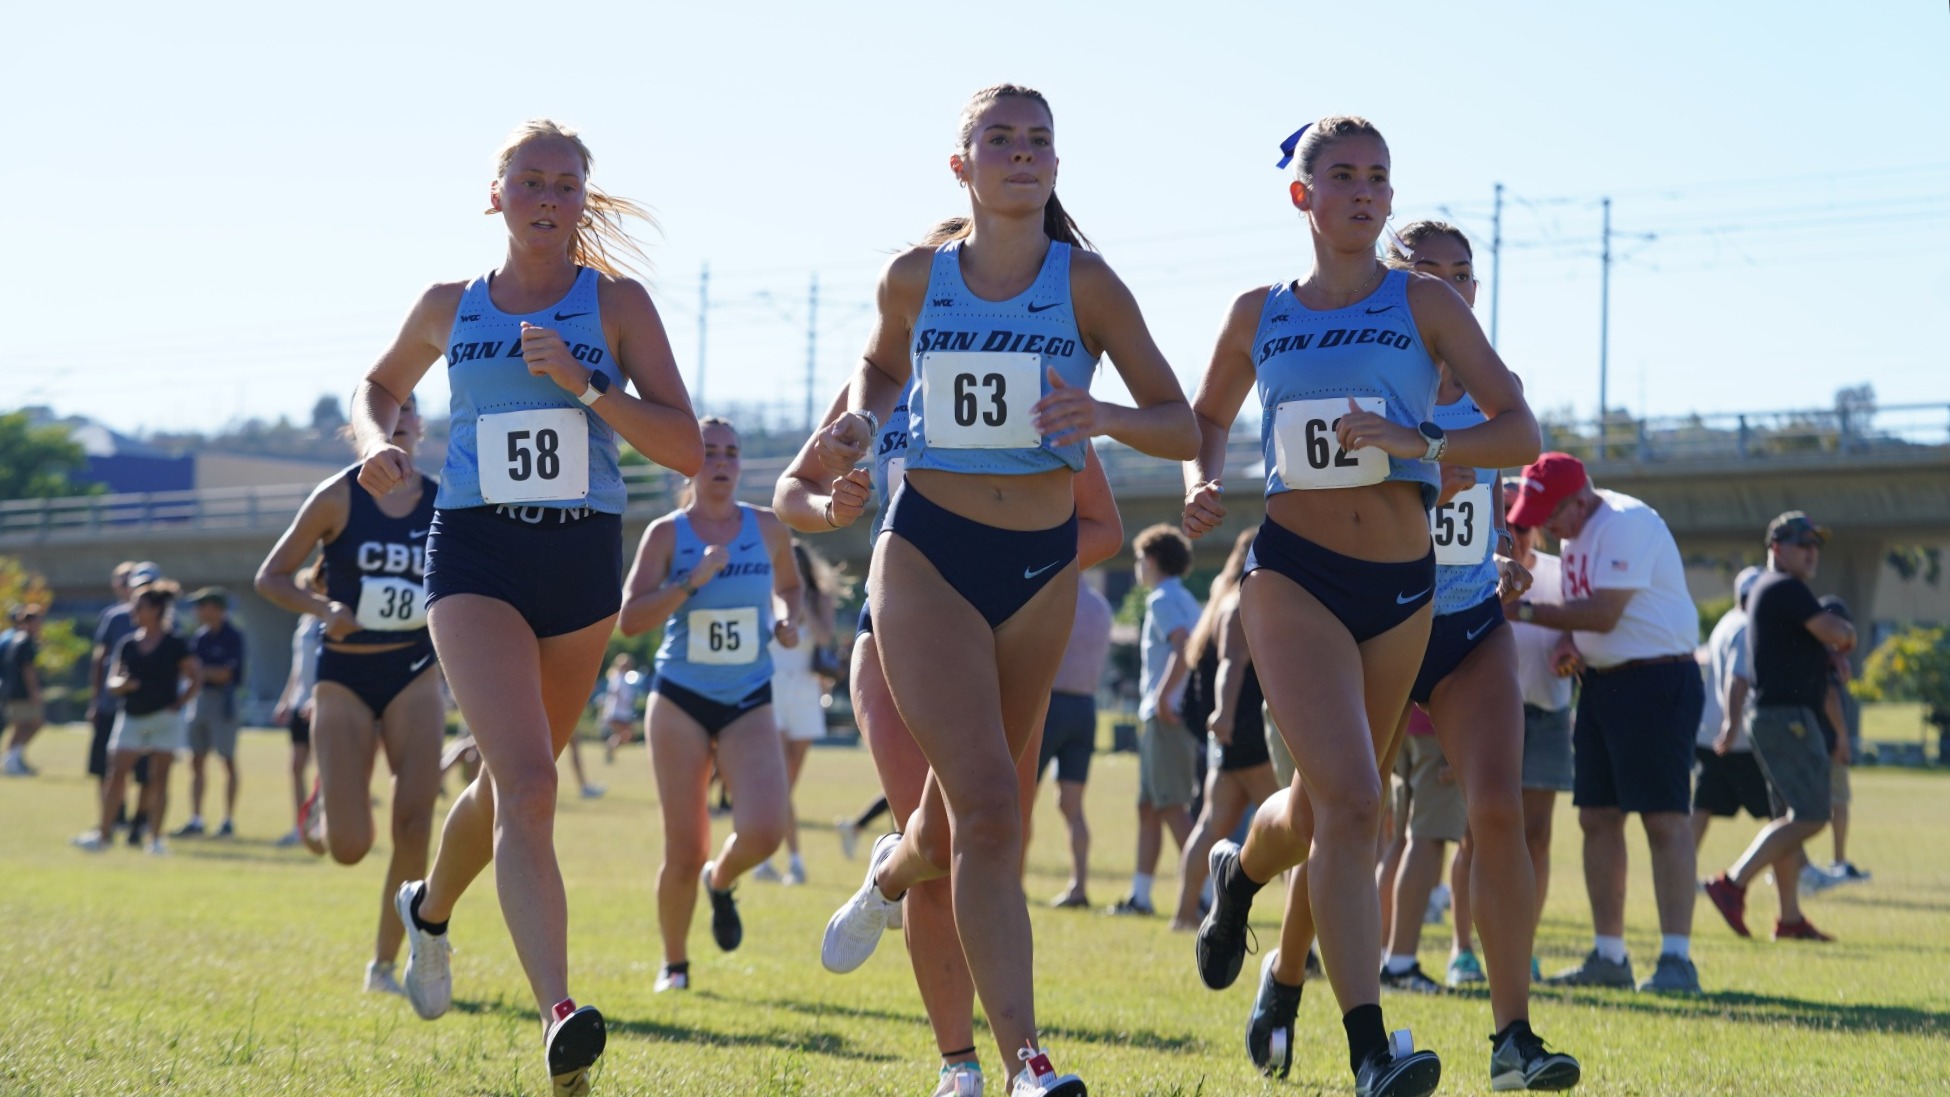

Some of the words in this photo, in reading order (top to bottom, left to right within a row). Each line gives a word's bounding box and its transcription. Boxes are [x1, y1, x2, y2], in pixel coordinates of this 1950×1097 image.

[449, 341, 505, 368] SAN
[507, 338, 604, 365] DGO
[917, 328, 978, 355] SAN
[979, 330, 1076, 358] DIEGO
[1258, 333, 1316, 367] SAN
[1316, 328, 1412, 351] DIEGO
[954, 372, 1008, 427] 63
[508, 429, 559, 481] 58
[1305, 418, 1359, 470] 62
[1435, 502, 1474, 546] 53
[1561, 553, 1594, 598] SA
[380, 587, 413, 620] 38
[710, 621, 740, 652] 65
